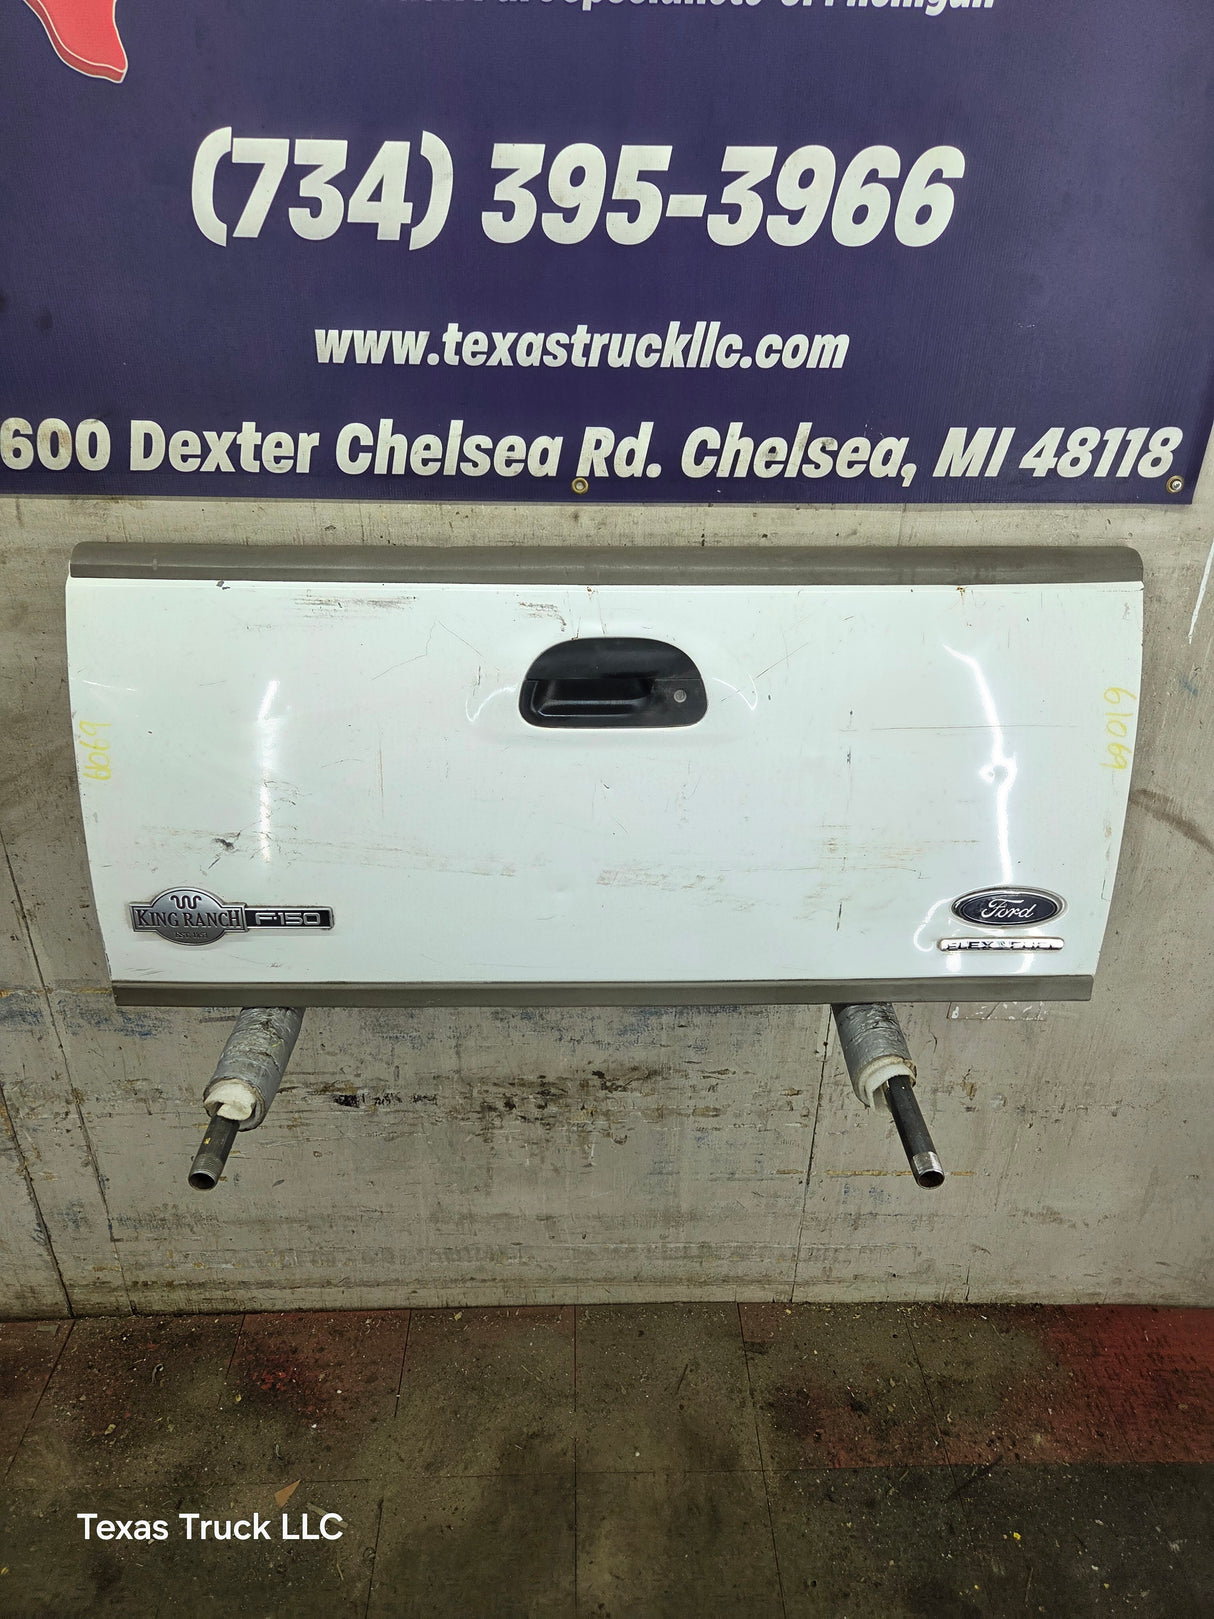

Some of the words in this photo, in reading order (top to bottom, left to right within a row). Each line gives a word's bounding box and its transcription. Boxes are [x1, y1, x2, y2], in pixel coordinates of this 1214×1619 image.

[191, 126, 454, 251] (734)
[481, 142, 966, 248] 395-3966
[314, 320, 850, 369] www.texastruckllc.com
[0, 417, 111, 471] 600
[130, 419, 320, 474] Dexter
[335, 418, 564, 477] Chelsea
[575, 421, 662, 478] Rd.
[681, 421, 917, 488] Chelsea,
[932, 426, 1016, 478] MI
[1018, 426, 1184, 479] 48118
[136, 909, 179, 928] KING
[183, 909, 241, 928] RANCH
[980, 898, 1037, 918] Ford
